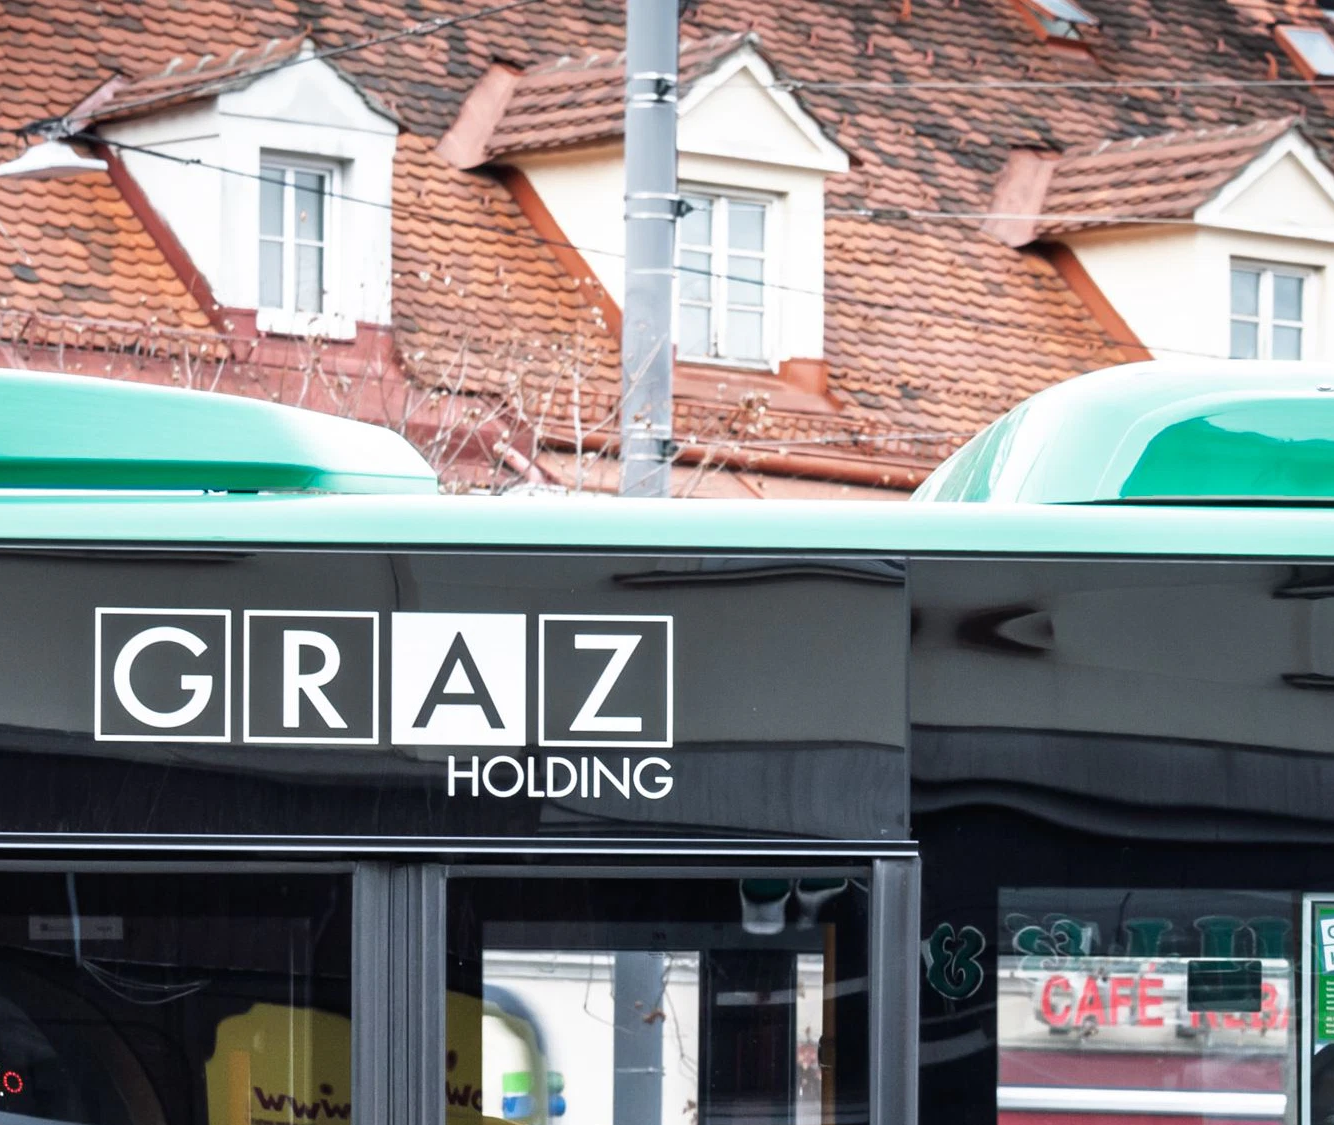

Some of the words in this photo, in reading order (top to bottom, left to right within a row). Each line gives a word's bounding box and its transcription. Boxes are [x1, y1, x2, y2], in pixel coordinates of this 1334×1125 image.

[107, 619, 650, 739] GRAZ
[448, 755, 673, 800] HOLDING
[1041, 963, 1165, 1028] CAFÉ
